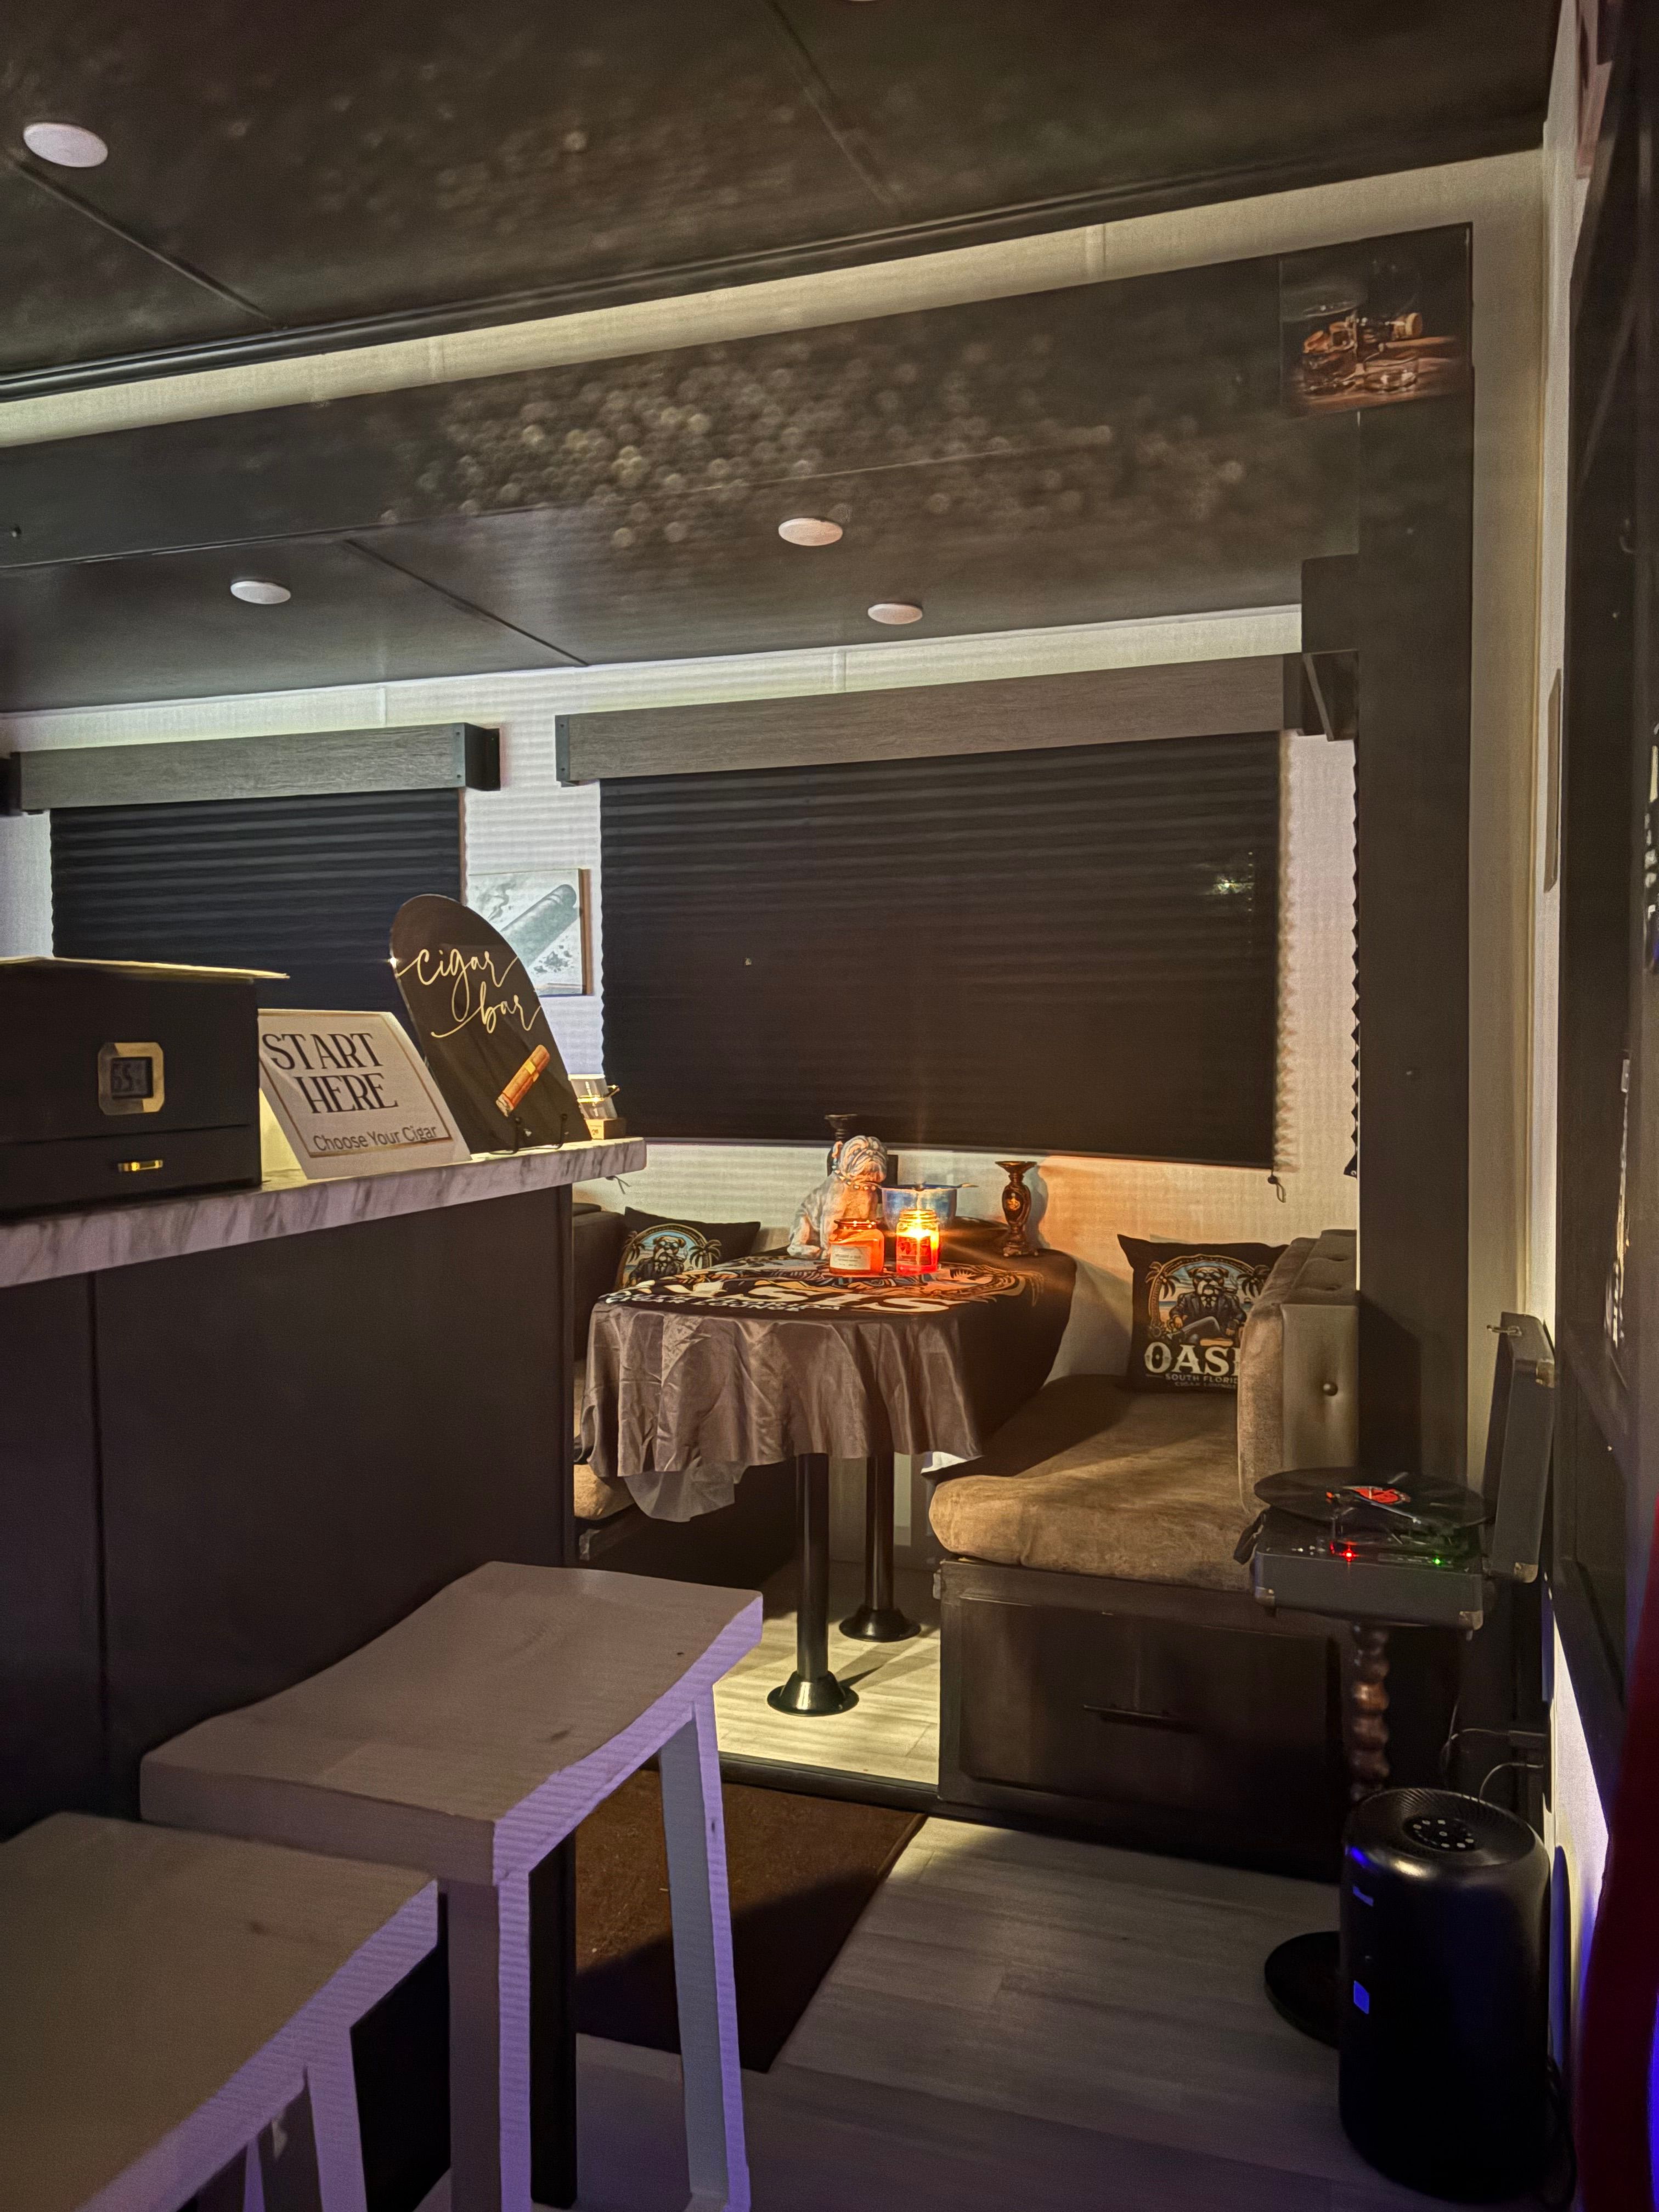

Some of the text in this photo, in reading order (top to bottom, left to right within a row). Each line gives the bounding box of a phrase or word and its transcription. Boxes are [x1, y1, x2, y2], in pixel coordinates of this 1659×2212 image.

[431, 981, 541, 1037] bar
[262, 1032, 383, 1070] START
[294, 1073, 399, 1113] HERE
[313, 1125, 437, 1151] Choose Your Cigar
[692, 1301, 800, 1311] LOUNGE
